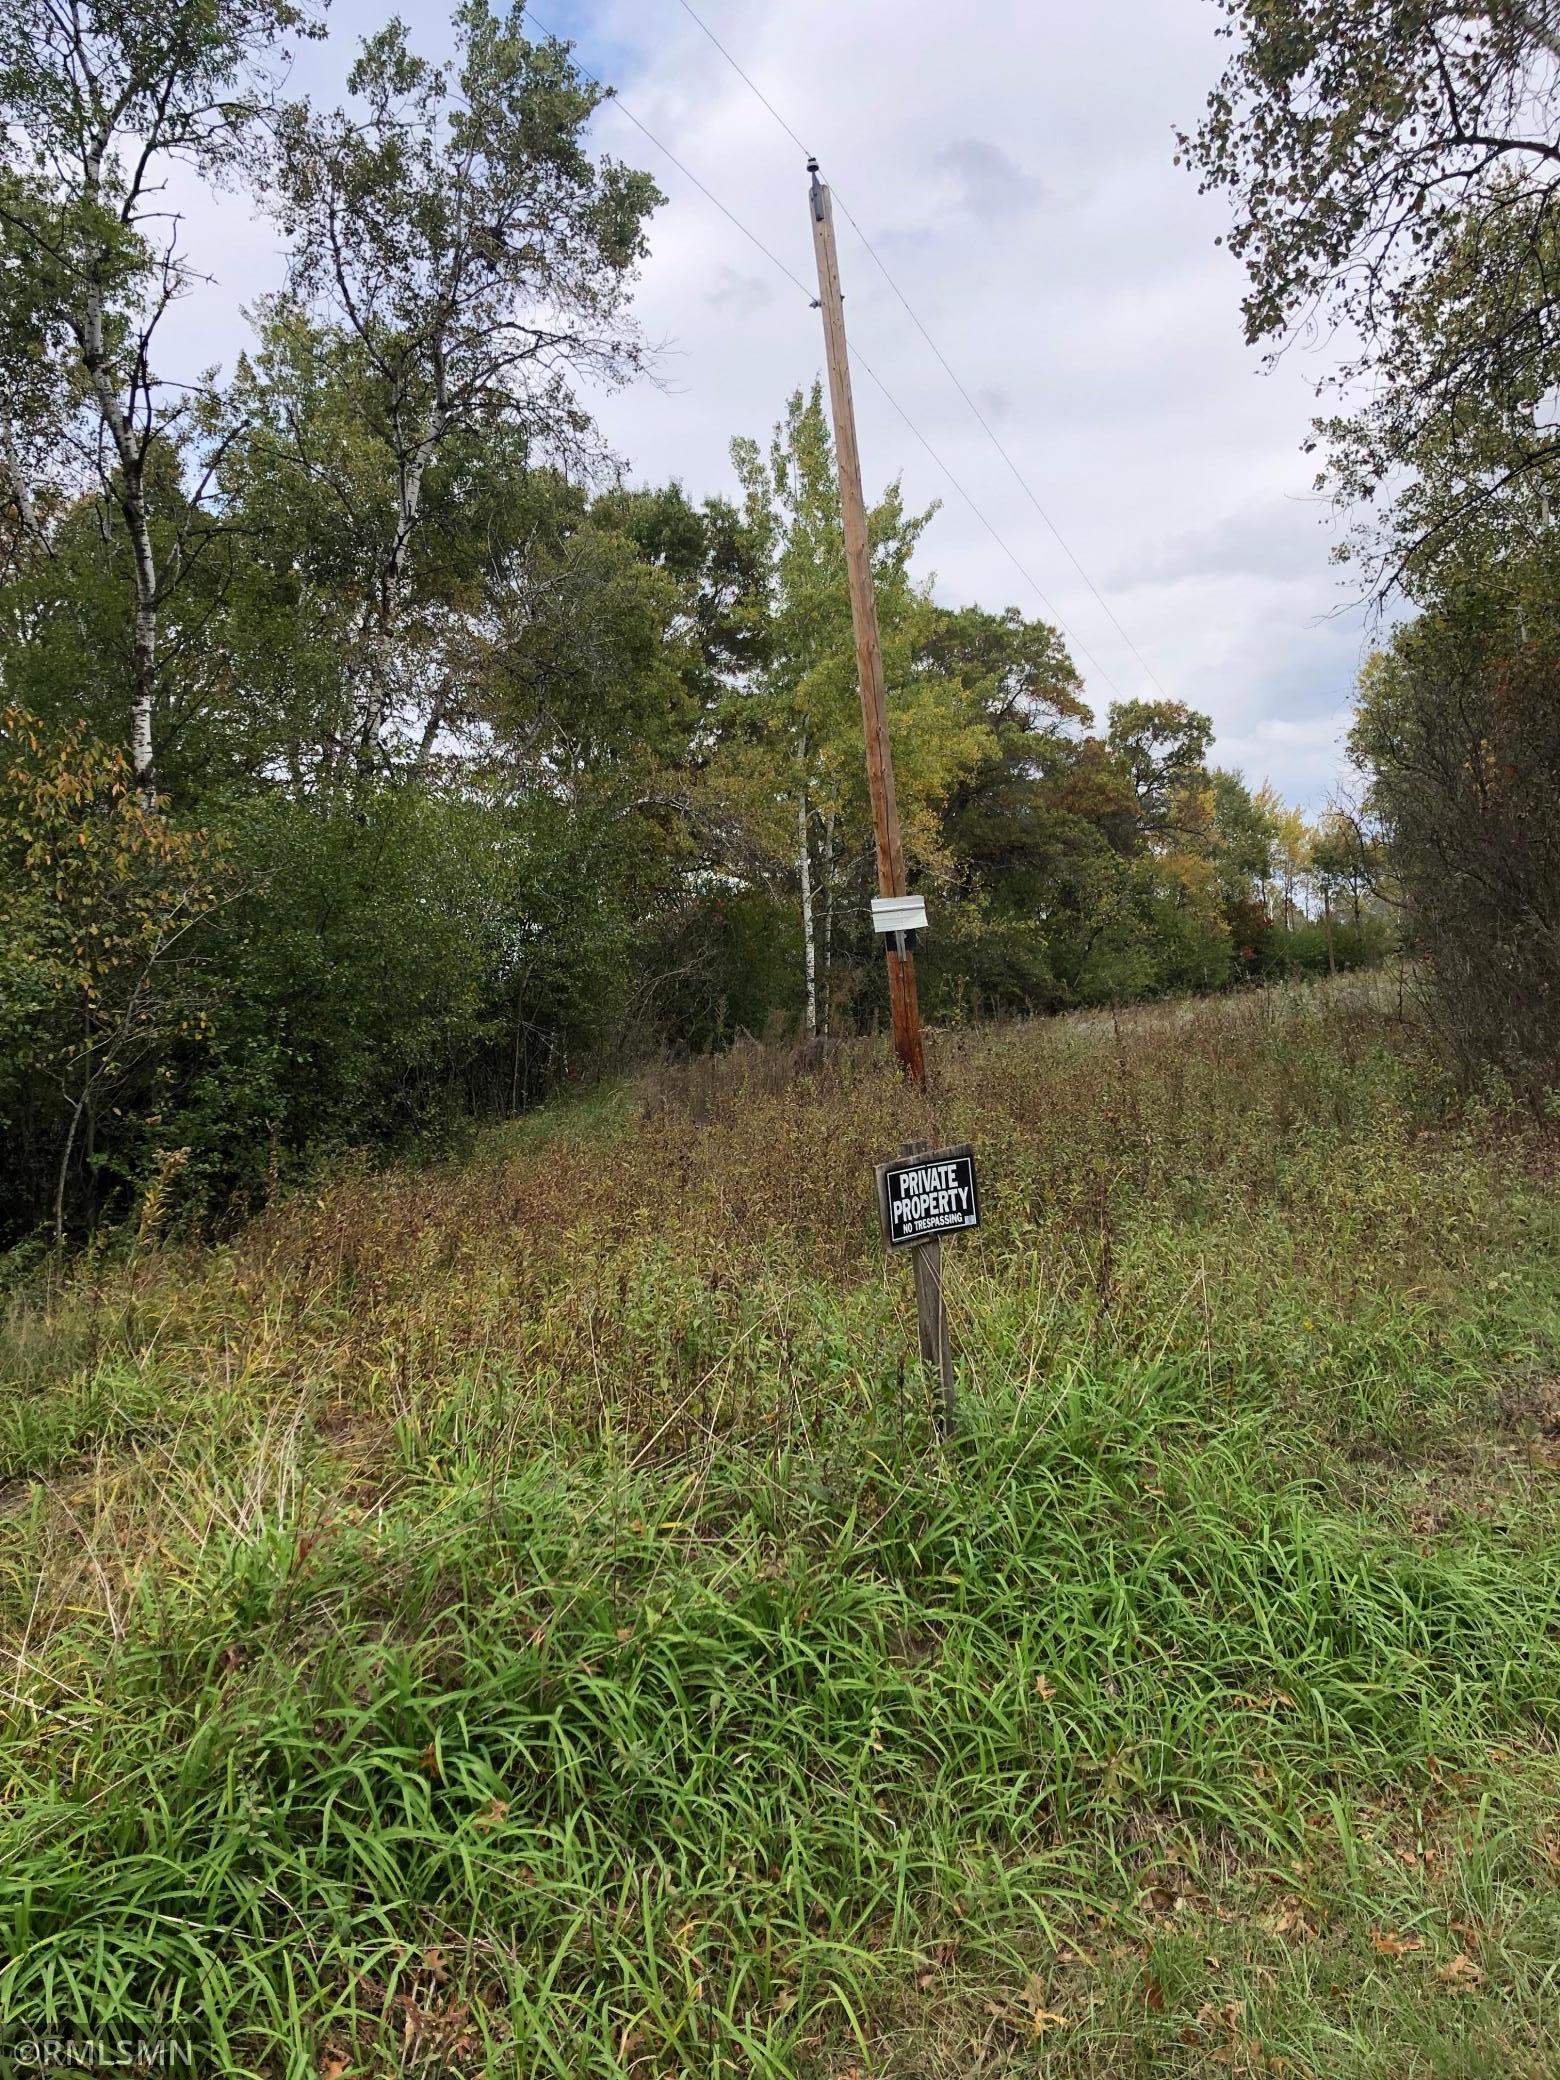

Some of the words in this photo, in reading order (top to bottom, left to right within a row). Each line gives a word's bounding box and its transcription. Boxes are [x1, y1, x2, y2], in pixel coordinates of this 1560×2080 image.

[900, 1164, 958, 1198] PRIVATE
[893, 1187, 968, 1224] PROPERTY
[903, 1223, 913, 1234] NO
[914, 1212, 962, 1231] TRESPASSING
